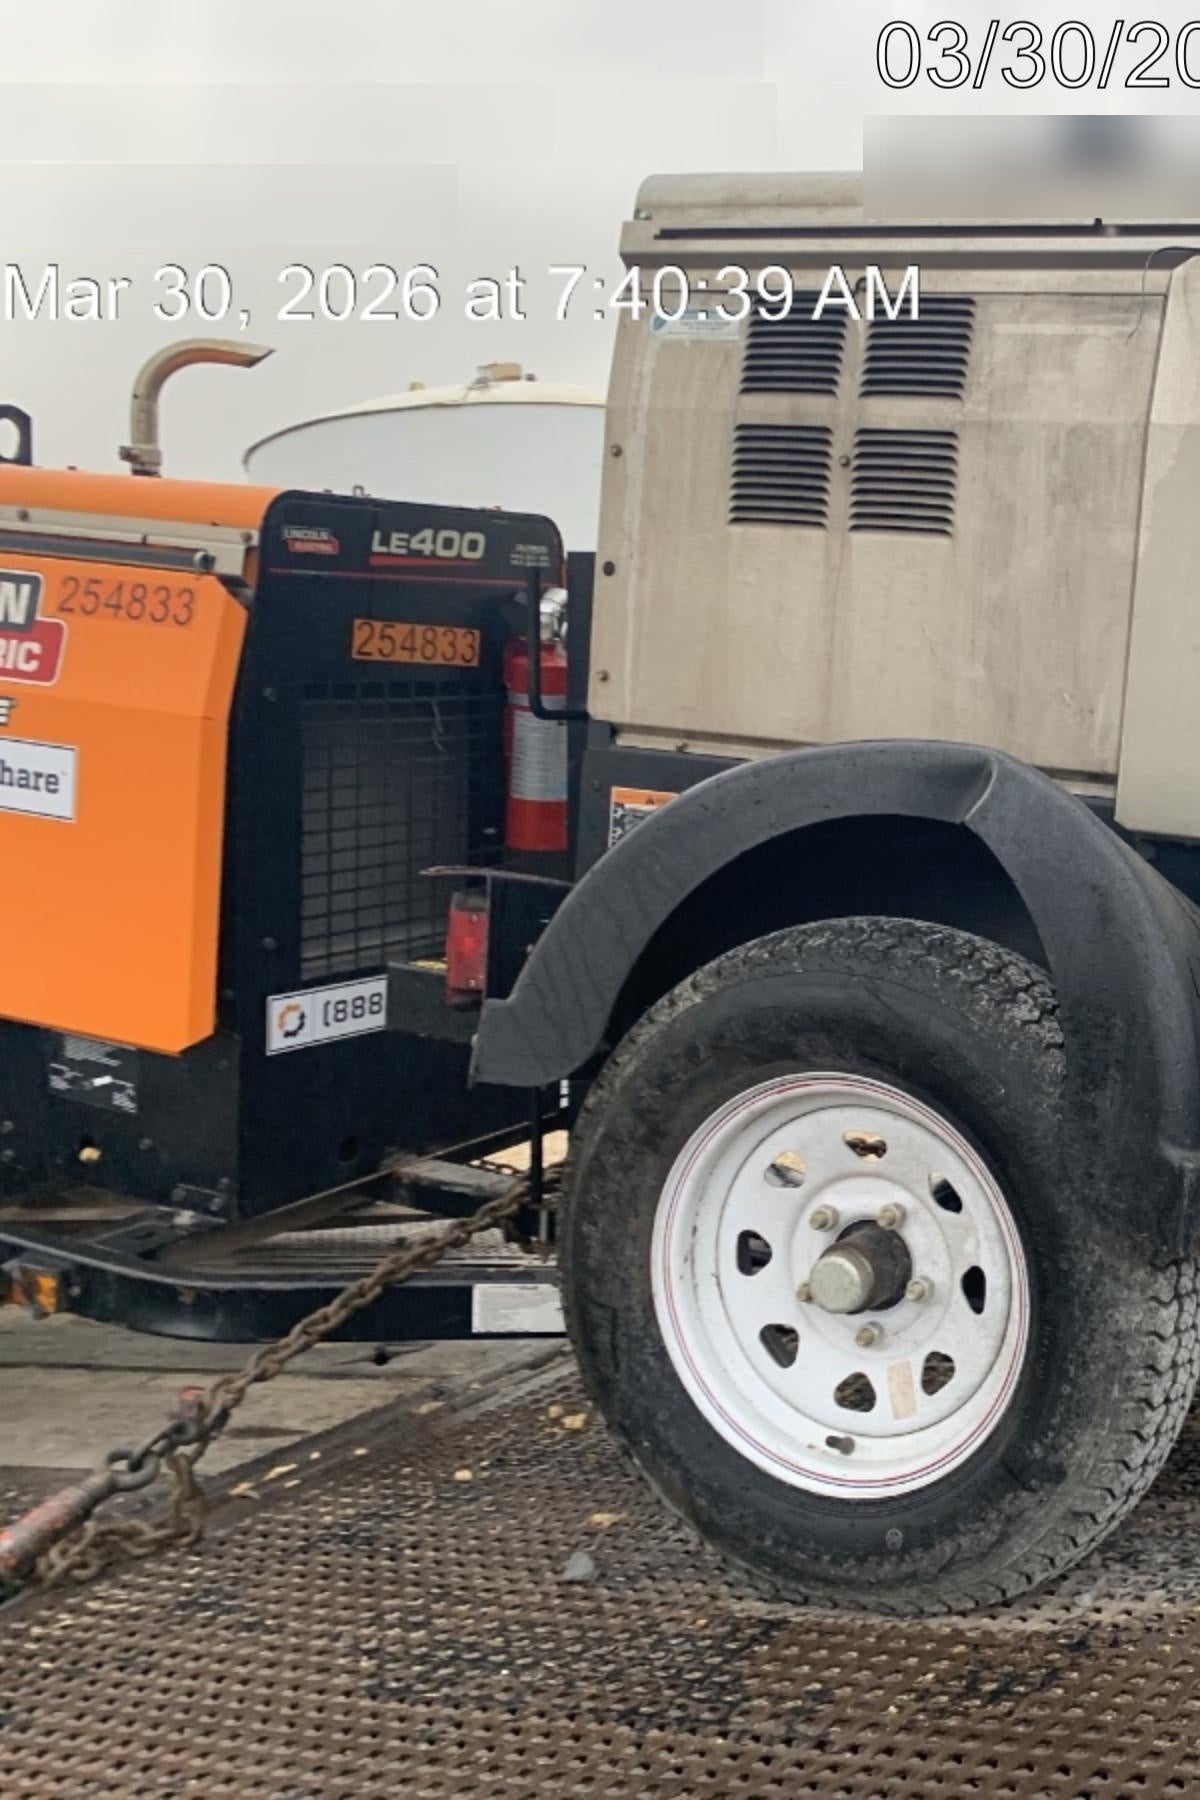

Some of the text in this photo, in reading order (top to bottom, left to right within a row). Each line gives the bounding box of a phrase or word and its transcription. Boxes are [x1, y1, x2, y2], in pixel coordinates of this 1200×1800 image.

[371, 528, 486, 559] LE400
[58, 575, 195, 627] 254833
[356, 621, 477, 663] 254833
